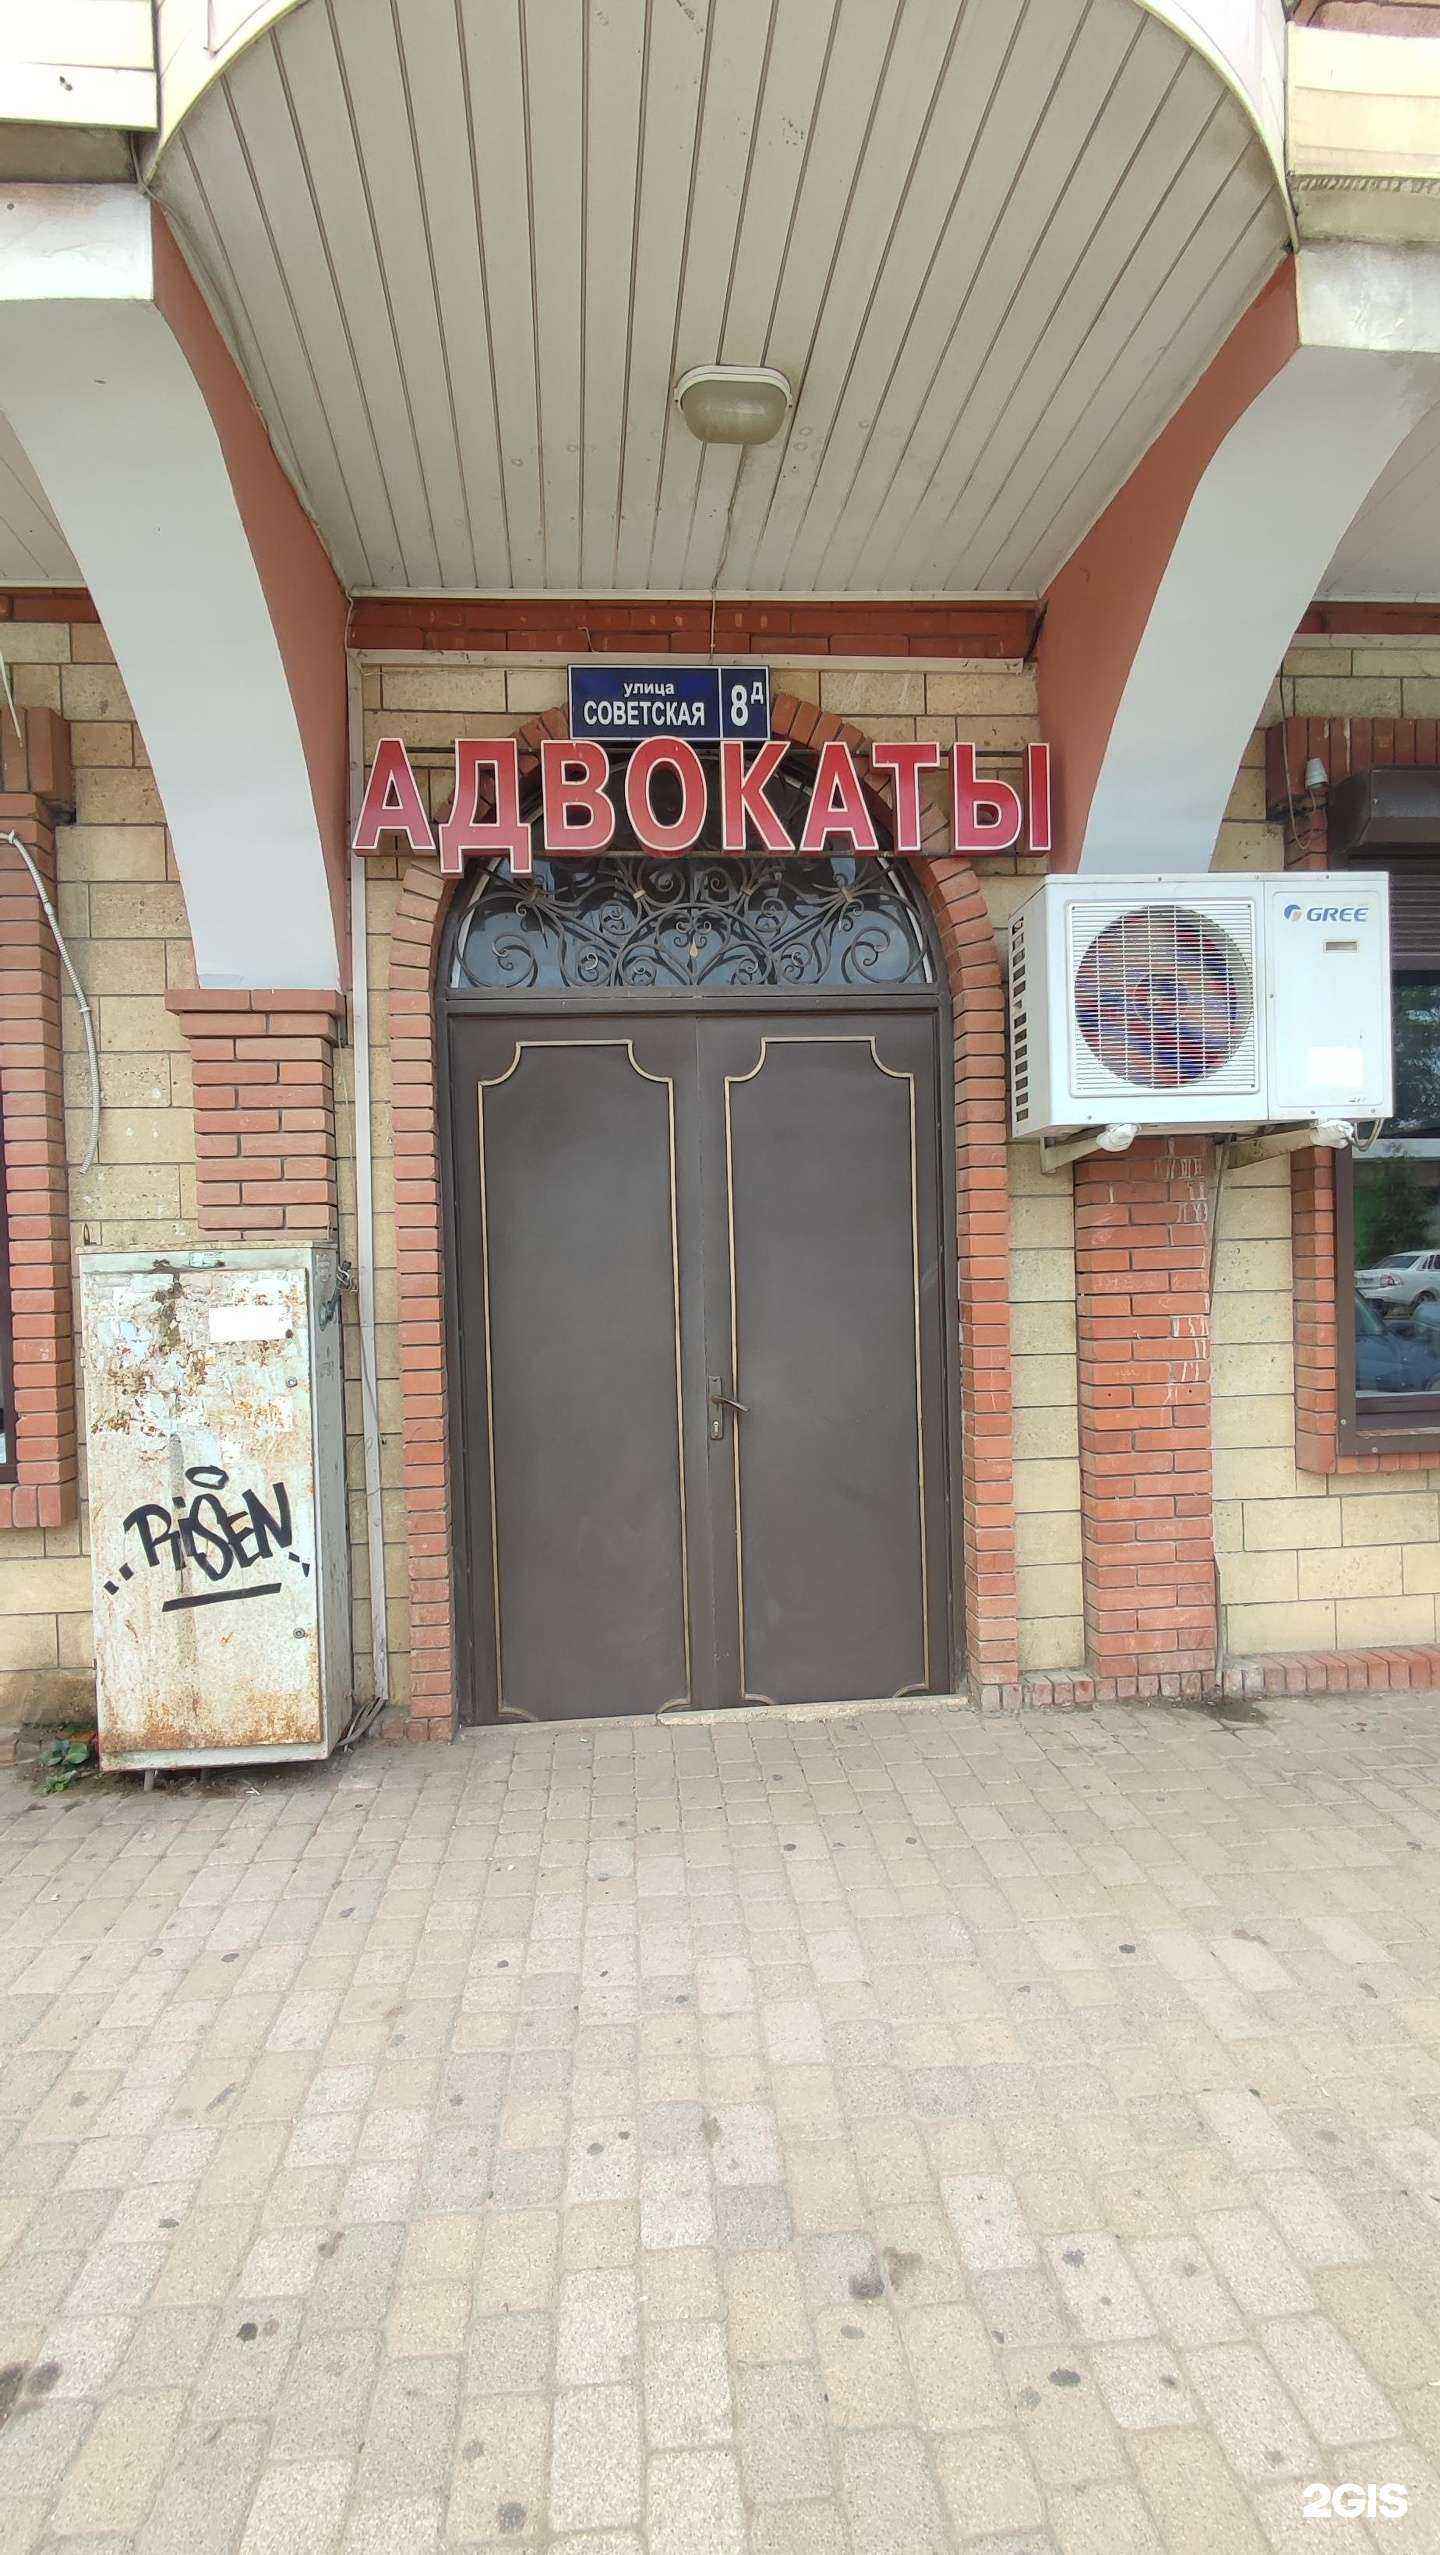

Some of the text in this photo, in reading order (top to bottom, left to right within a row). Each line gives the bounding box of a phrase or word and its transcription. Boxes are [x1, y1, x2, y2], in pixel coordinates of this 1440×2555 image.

[624, 682, 675, 697] улица
[583, 700, 705, 726] СОВЕТСКАЯ
[351, 735, 1052, 874] АДВОКАТЫ
[1306, 907, 1369, 922] GREE
